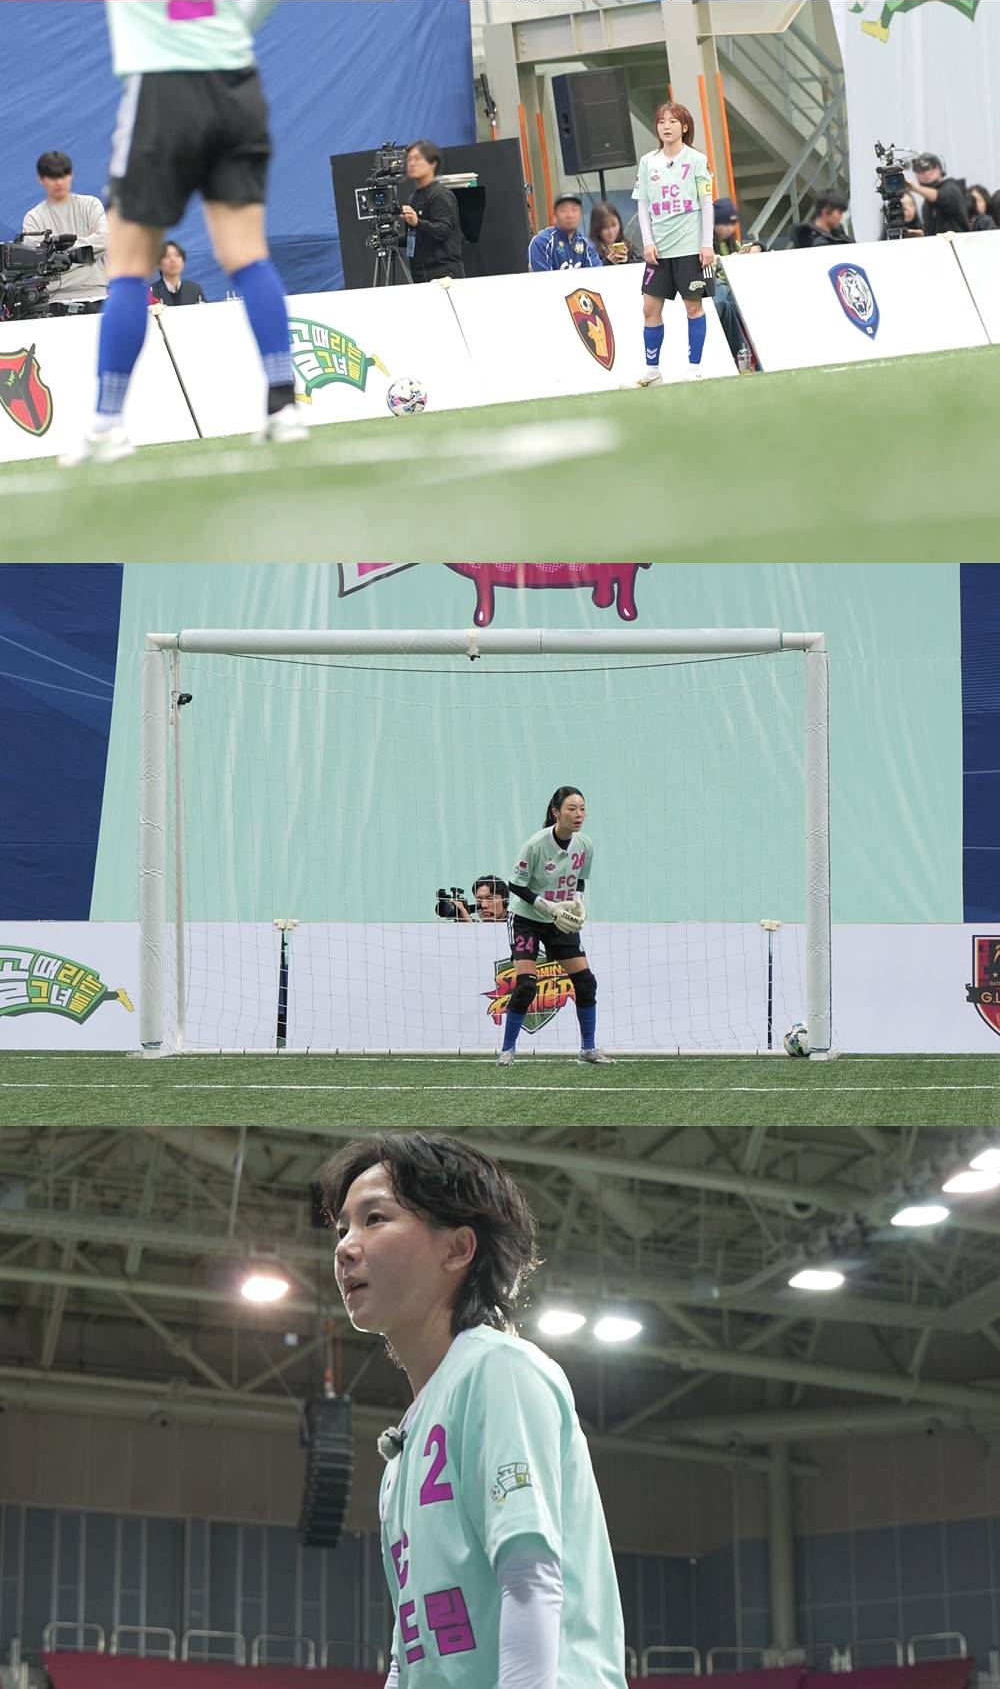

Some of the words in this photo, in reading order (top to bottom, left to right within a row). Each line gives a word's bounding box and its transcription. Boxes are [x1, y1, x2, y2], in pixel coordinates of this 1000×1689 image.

[681, 163, 691, 180] 7
[661, 184, 680, 198] FC
[645, 268, 656, 285] 7
[557, 874, 576, 889] FC
[562, 912, 580, 924] TITAN
[515, 935, 535, 953] 24
[31, 980, 92, 1013] 그녀들
[419, 1423, 454, 1507] 2
